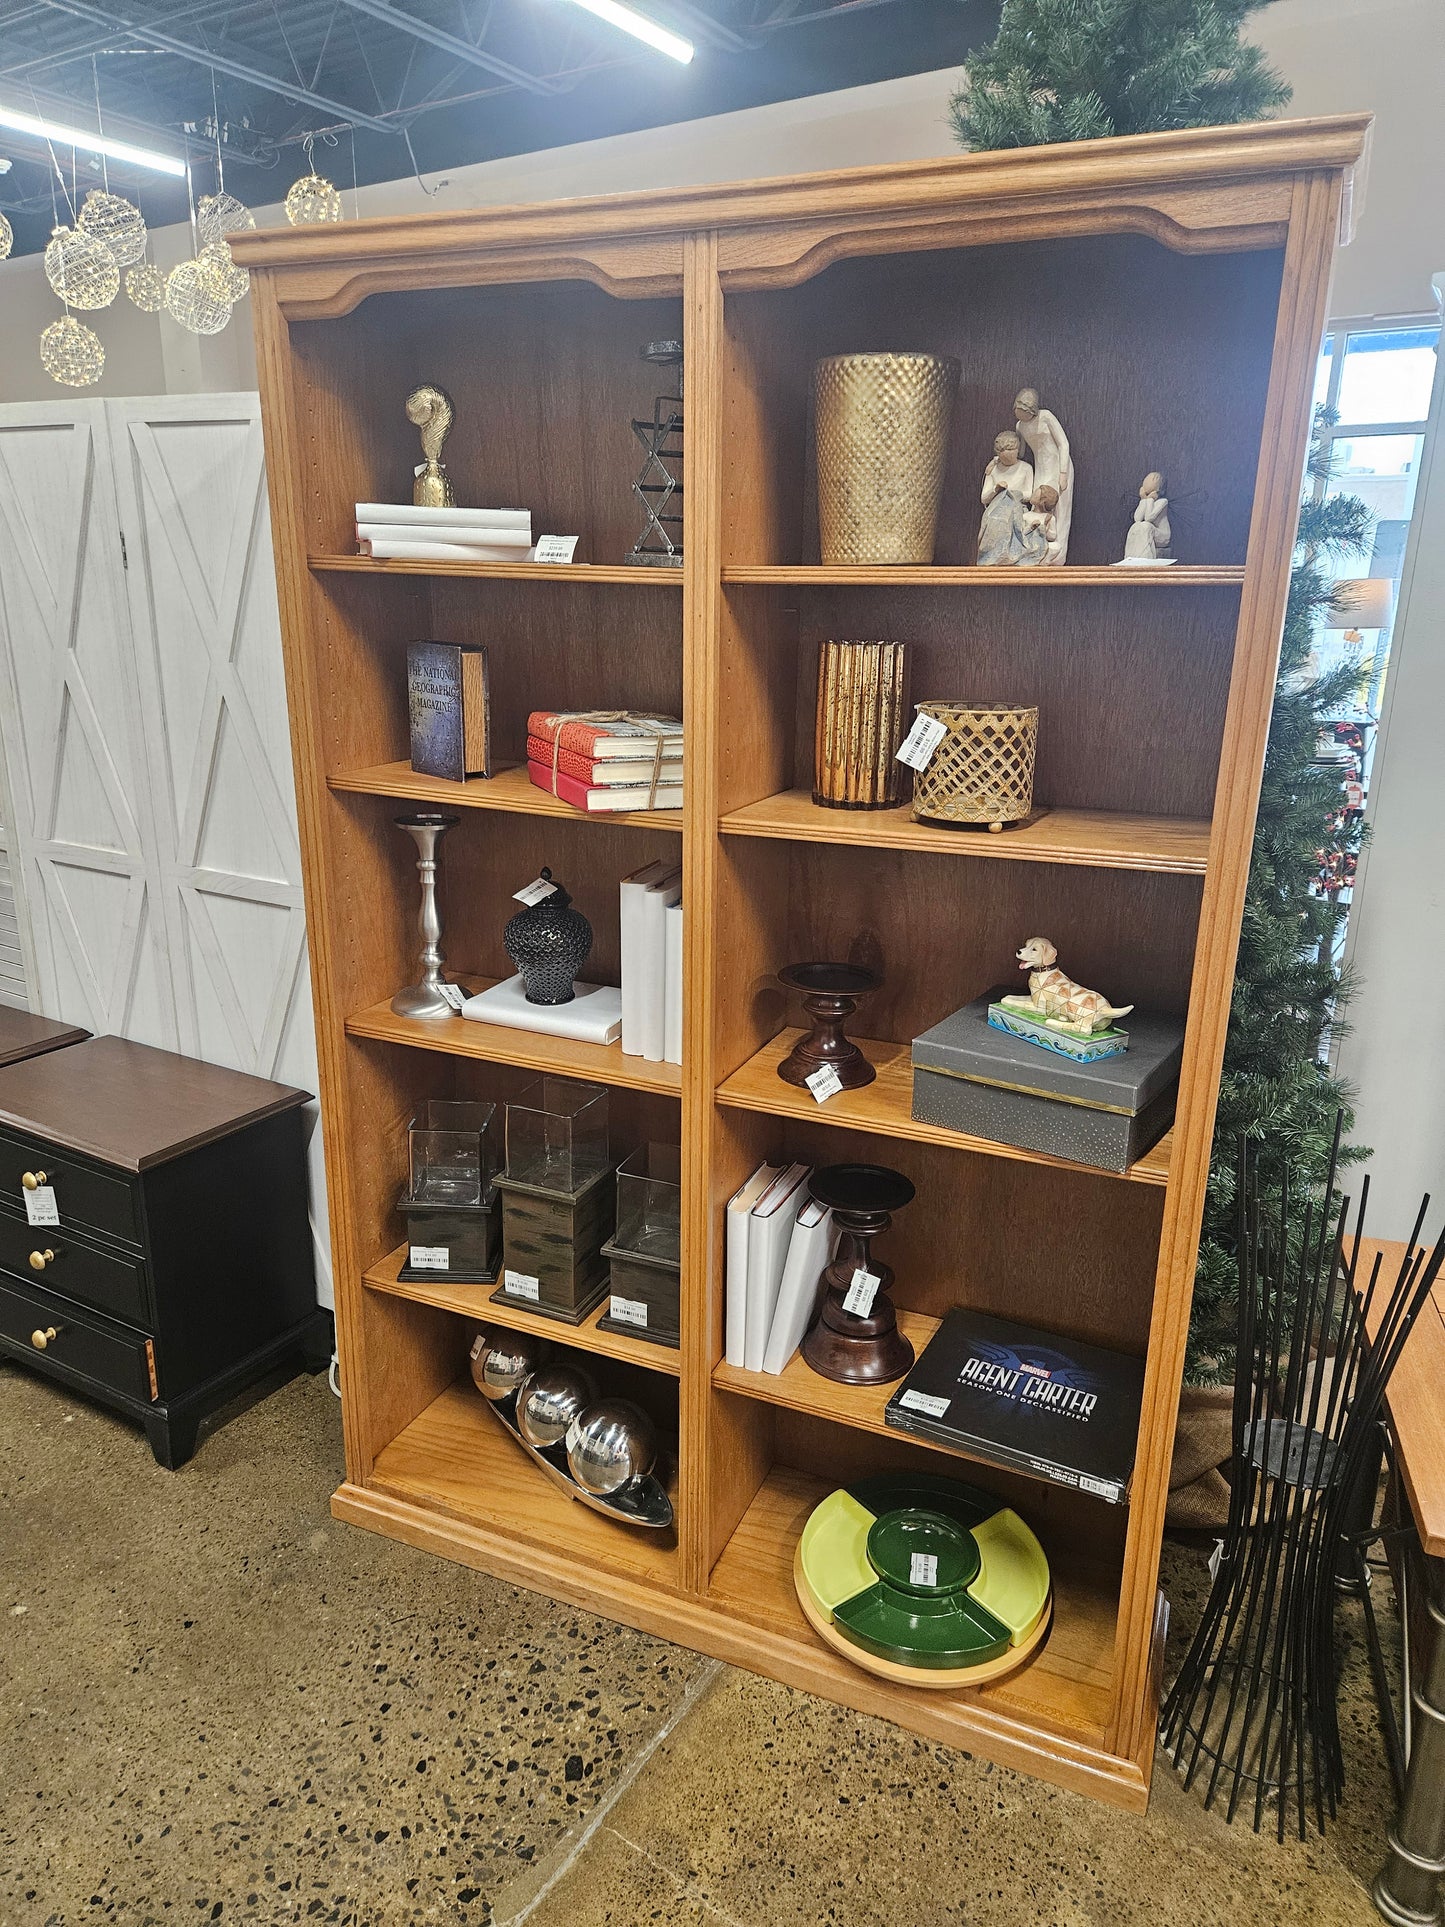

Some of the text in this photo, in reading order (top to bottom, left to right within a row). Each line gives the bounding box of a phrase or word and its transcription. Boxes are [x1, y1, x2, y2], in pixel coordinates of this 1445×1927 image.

[409, 664, 422, 677] THE
[412, 680, 456, 698] GEOGRAPHIC
[417, 697, 453, 713] MAGAZINE
[1020, 1363, 1051, 1379] MARVEL
[960, 1357, 1098, 1417] AGENT CARTER
[957, 1377, 1090, 1423] SEASON ONE DECLASSIFIED
